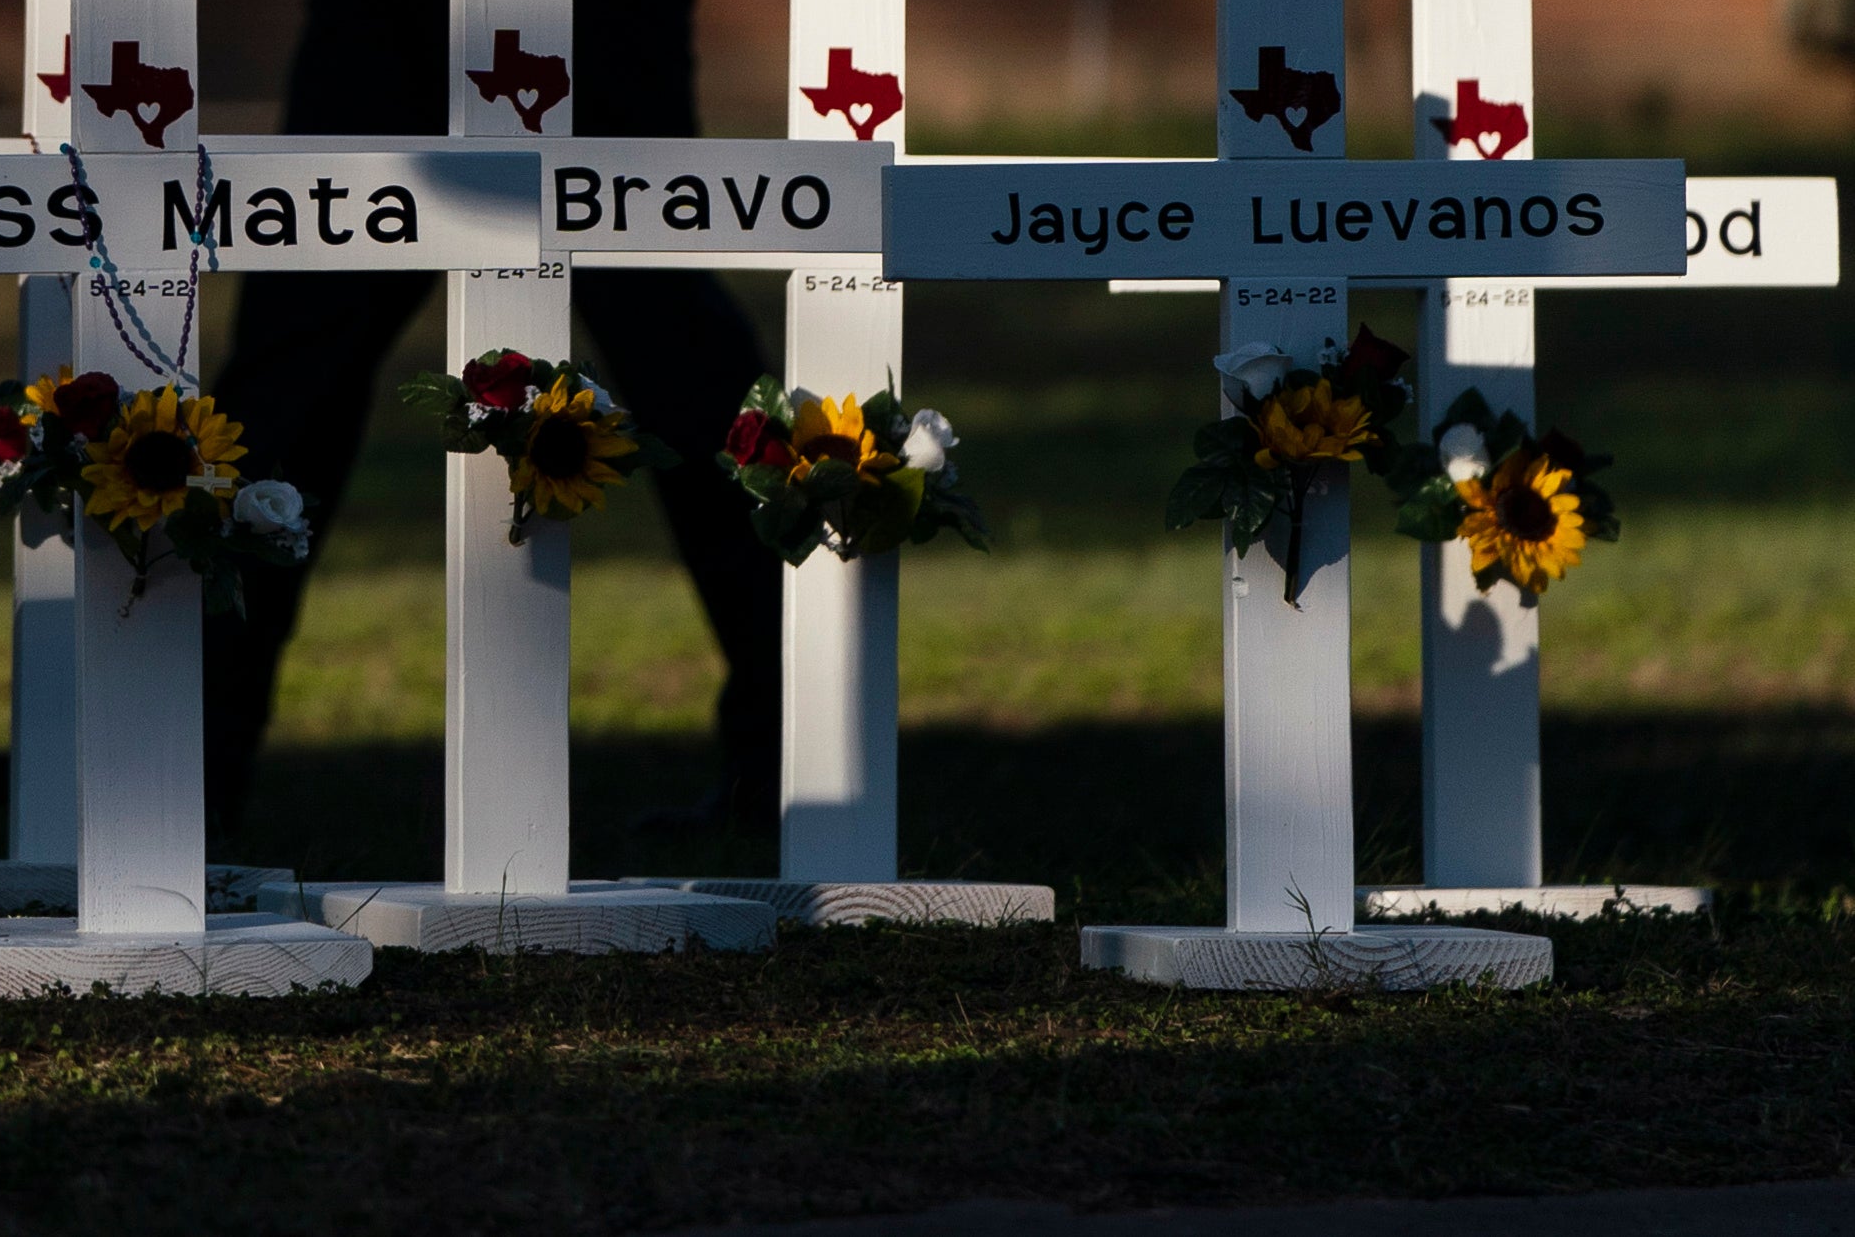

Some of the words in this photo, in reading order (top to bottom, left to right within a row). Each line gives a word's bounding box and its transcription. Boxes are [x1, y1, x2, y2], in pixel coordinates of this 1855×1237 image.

[163, 177, 419, 251] Mata
[555, 167, 831, 231] Bravo
[991, 193, 1195, 255] Jayce
[1251, 193, 1605, 244] Luevanos
[90, 279, 190, 297] 5-24-22
[1238, 287, 1337, 306] 5-24-22
